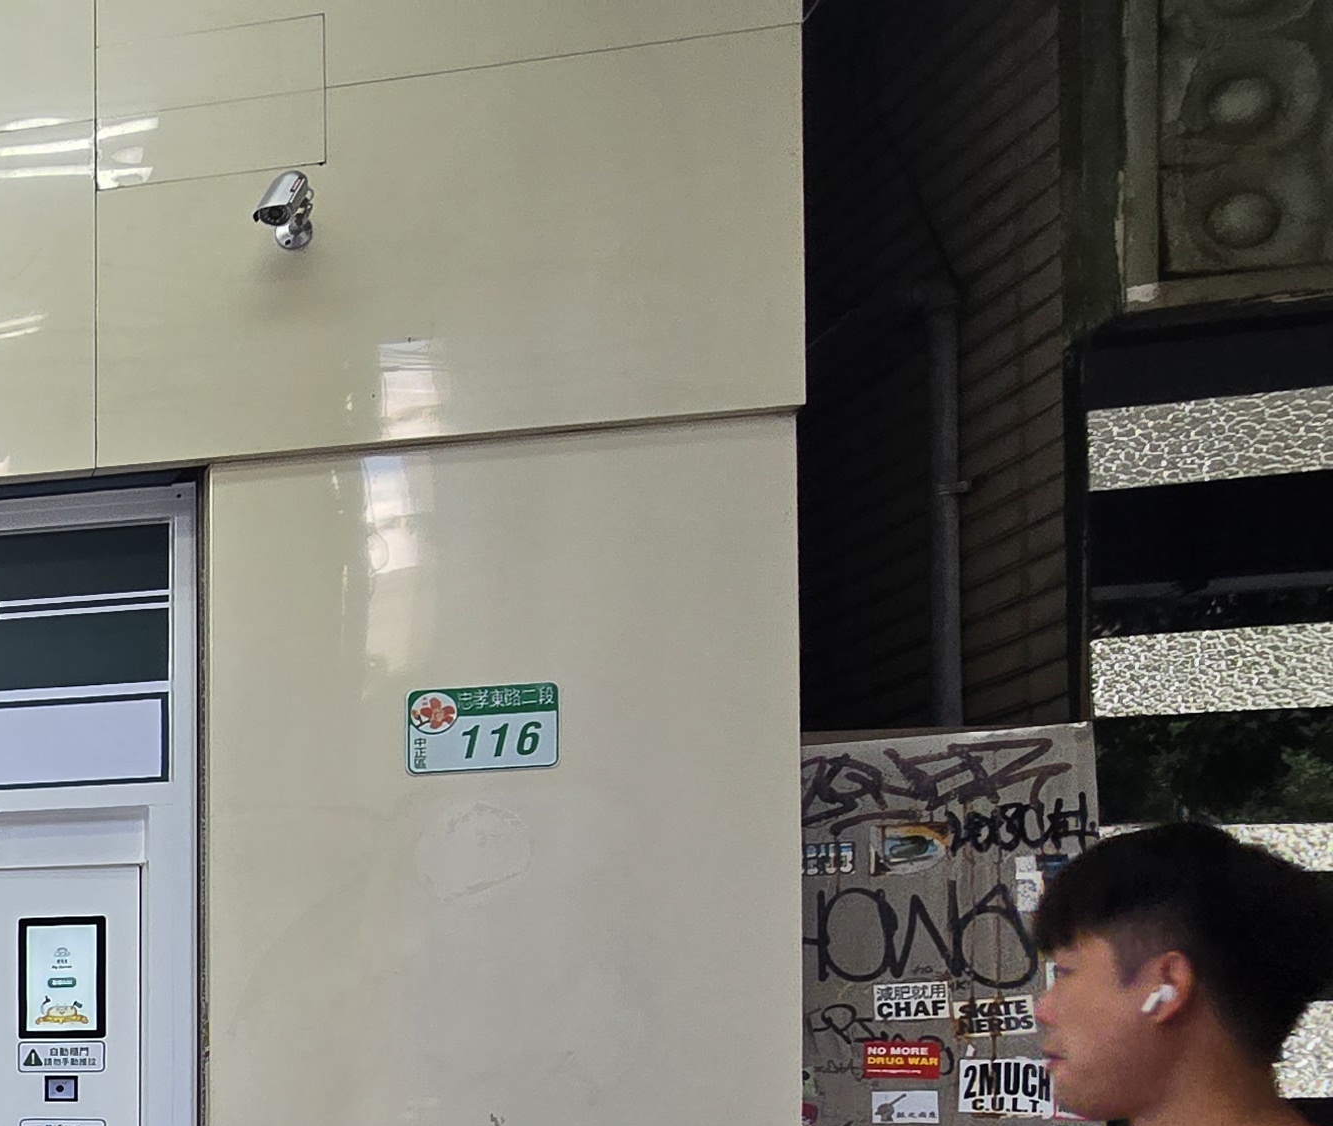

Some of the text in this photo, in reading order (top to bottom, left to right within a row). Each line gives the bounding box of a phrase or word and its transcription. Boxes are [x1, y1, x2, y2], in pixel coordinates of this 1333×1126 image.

[457, 686, 554, 711] 忠孝東路二段
[461, 721, 542, 759] 116
[877, 984, 946, 1000] 減肥就用
[877, 1000, 946, 1018] CHAF
[959, 1000, 1028, 1017] SKATE
[958, 1016, 1033, 1034] NERDS
[867, 1047, 929, 1055] NO MORE
[867, 1057, 939, 1066] DRUG WAR
[964, 1062, 1050, 1101] 2MUCH
